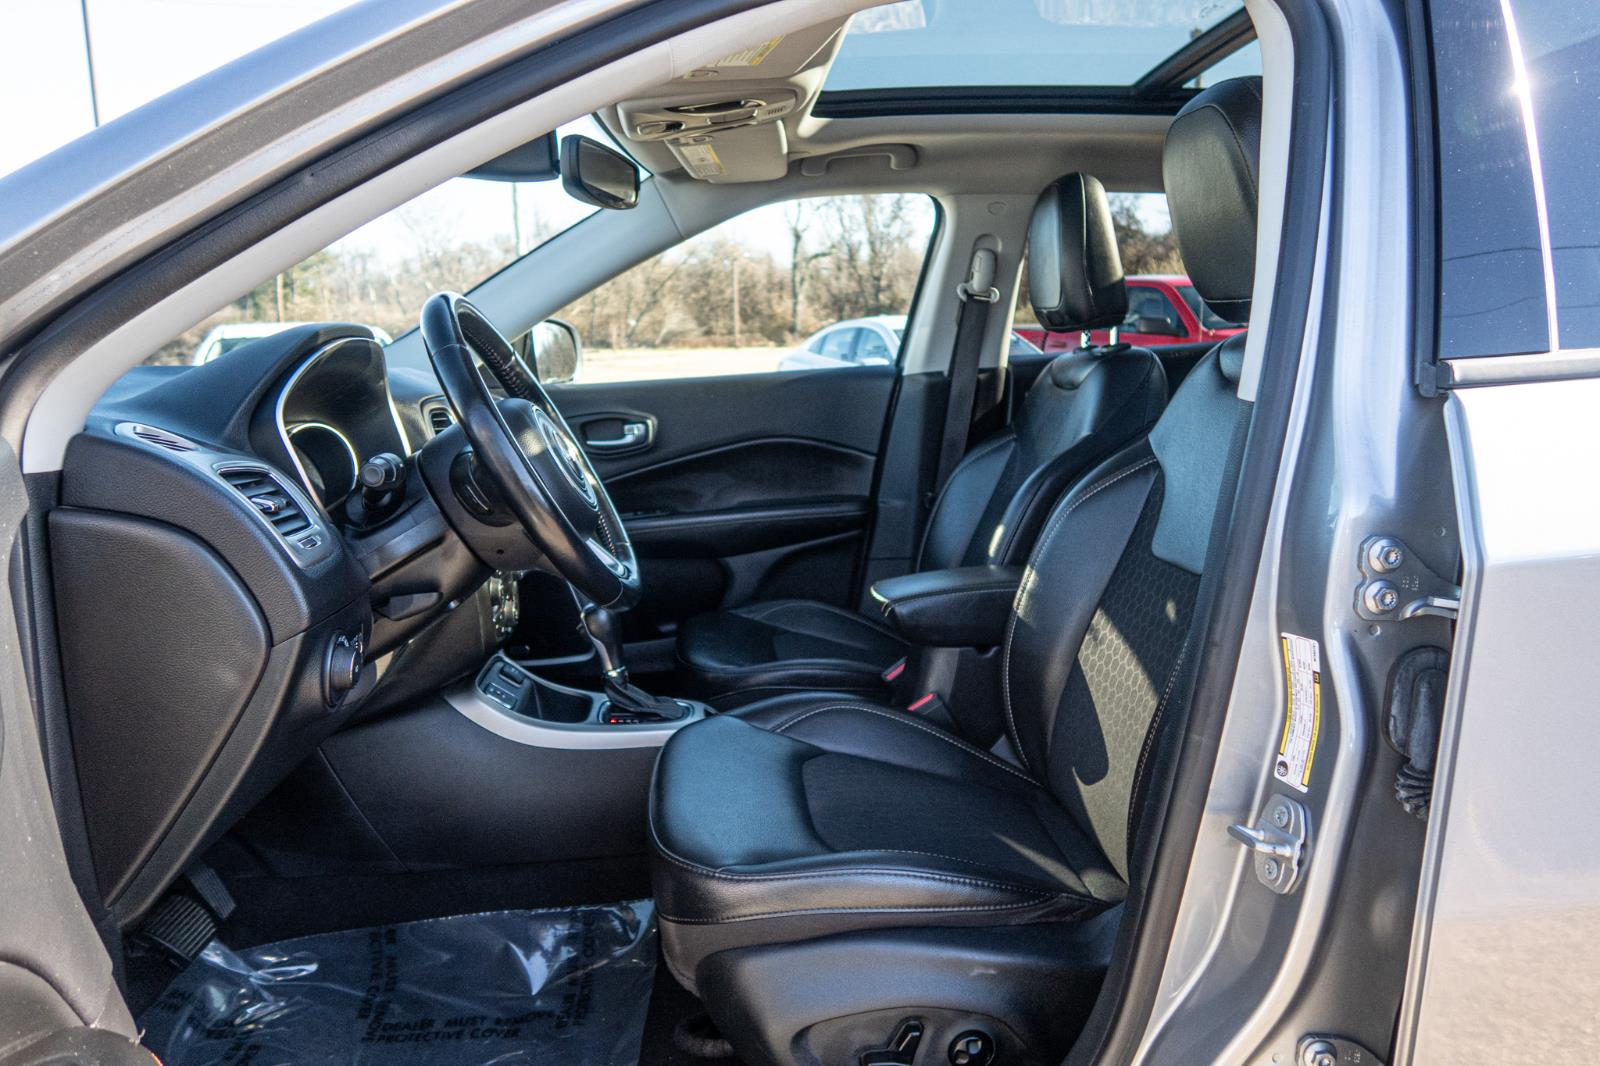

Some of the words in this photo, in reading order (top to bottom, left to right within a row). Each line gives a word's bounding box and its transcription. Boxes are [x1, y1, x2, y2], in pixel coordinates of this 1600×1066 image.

[380, 1018, 436, 1031] DEALER
[443, 1015, 488, 1029] MUST
[493, 1009, 556, 1026] REMOVE
[375, 1029, 462, 1043] PROTECTIVE
[469, 1027, 521, 1039] COVER
